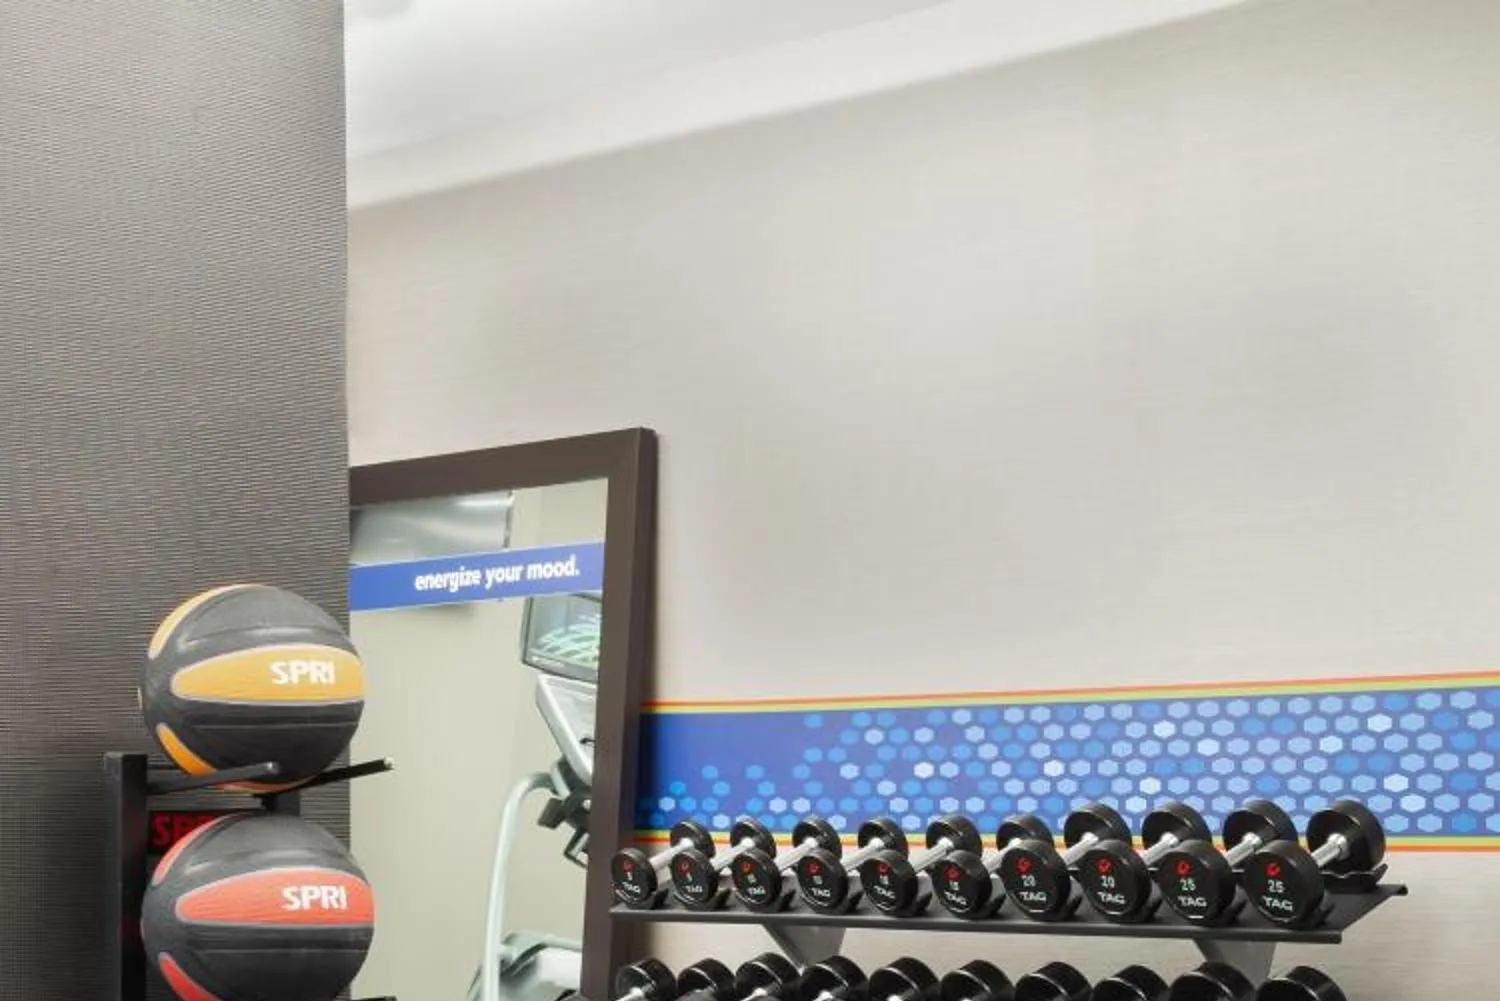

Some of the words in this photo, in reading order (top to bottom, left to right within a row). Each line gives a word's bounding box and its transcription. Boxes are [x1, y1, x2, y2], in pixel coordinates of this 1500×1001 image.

[414, 564, 481, 593] energize
[484, 563, 523, 590] your
[527, 553, 580, 579] mood.
[269, 660, 335, 686] SPRI
[810, 887, 831, 897] TAG
[1267, 879, 1285, 894] 25
[281, 884, 347, 912] SPRI
[1019, 891, 1047, 902] TAG
[1097, 891, 1126, 905] TAG
[1177, 895, 1207, 908] TAG
[1262, 895, 1294, 912] TAG
